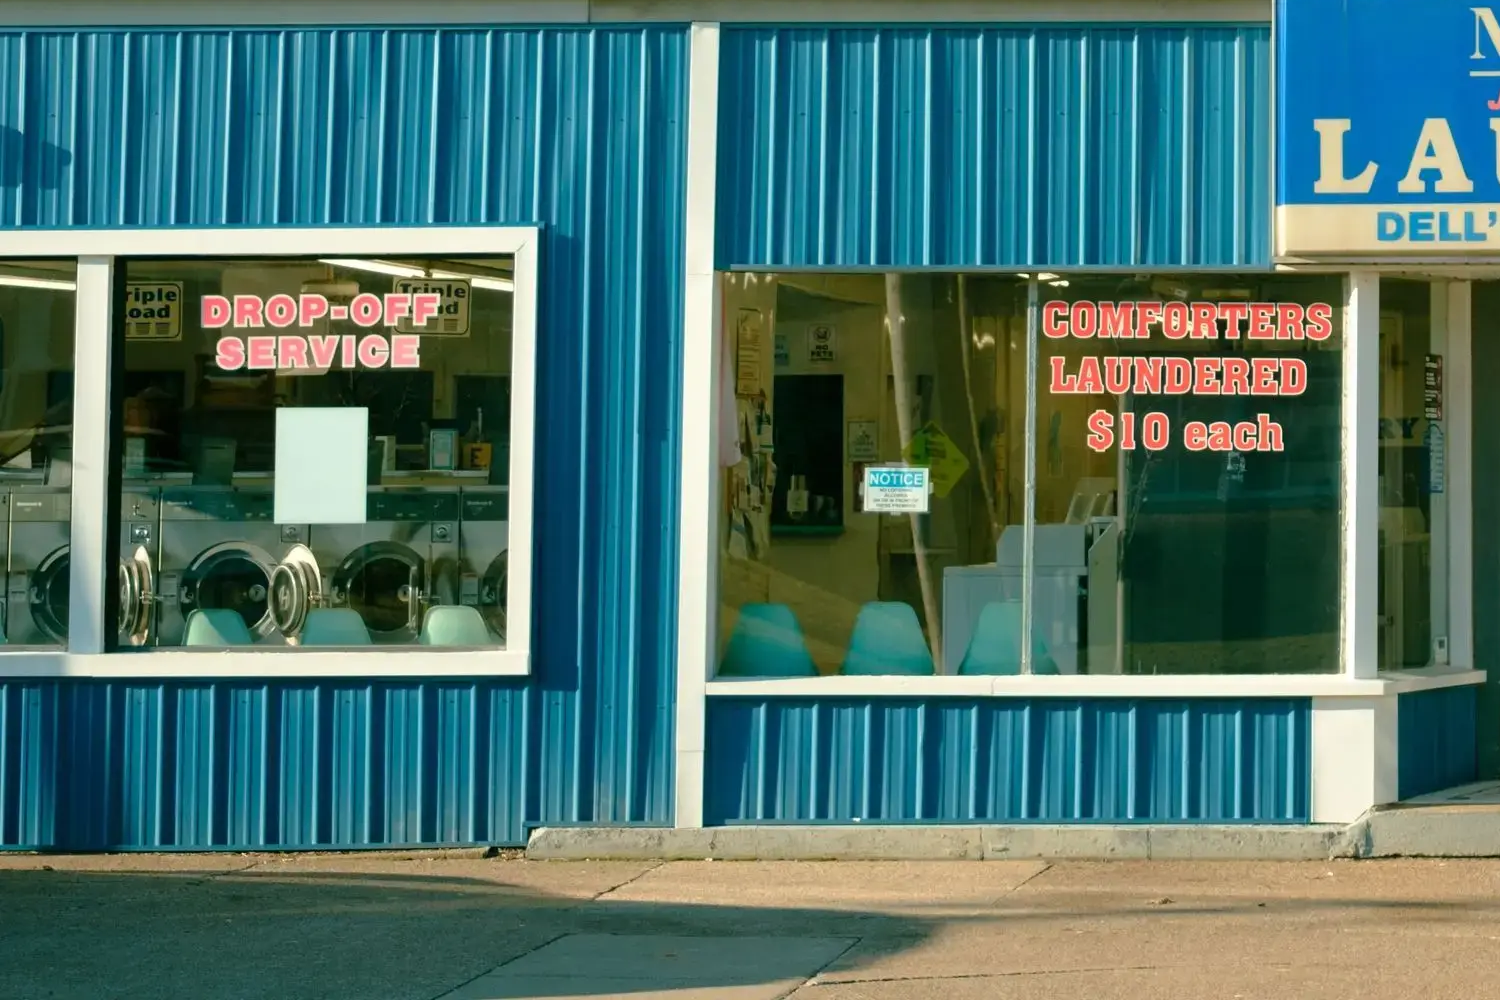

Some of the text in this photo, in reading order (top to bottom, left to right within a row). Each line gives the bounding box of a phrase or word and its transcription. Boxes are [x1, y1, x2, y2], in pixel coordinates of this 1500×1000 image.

[126, 287, 177, 305] riple
[127, 304, 170, 319] oad
[200, 293, 440, 328] DROP-OFF
[1043, 301, 1332, 339] COMFORTERS
[216, 335, 420, 370] SERVICE
[1050, 356, 1307, 395] LAUNDERED
[1087, 410, 1284, 452] $10 each
[870, 473, 922, 485] NOTICE
